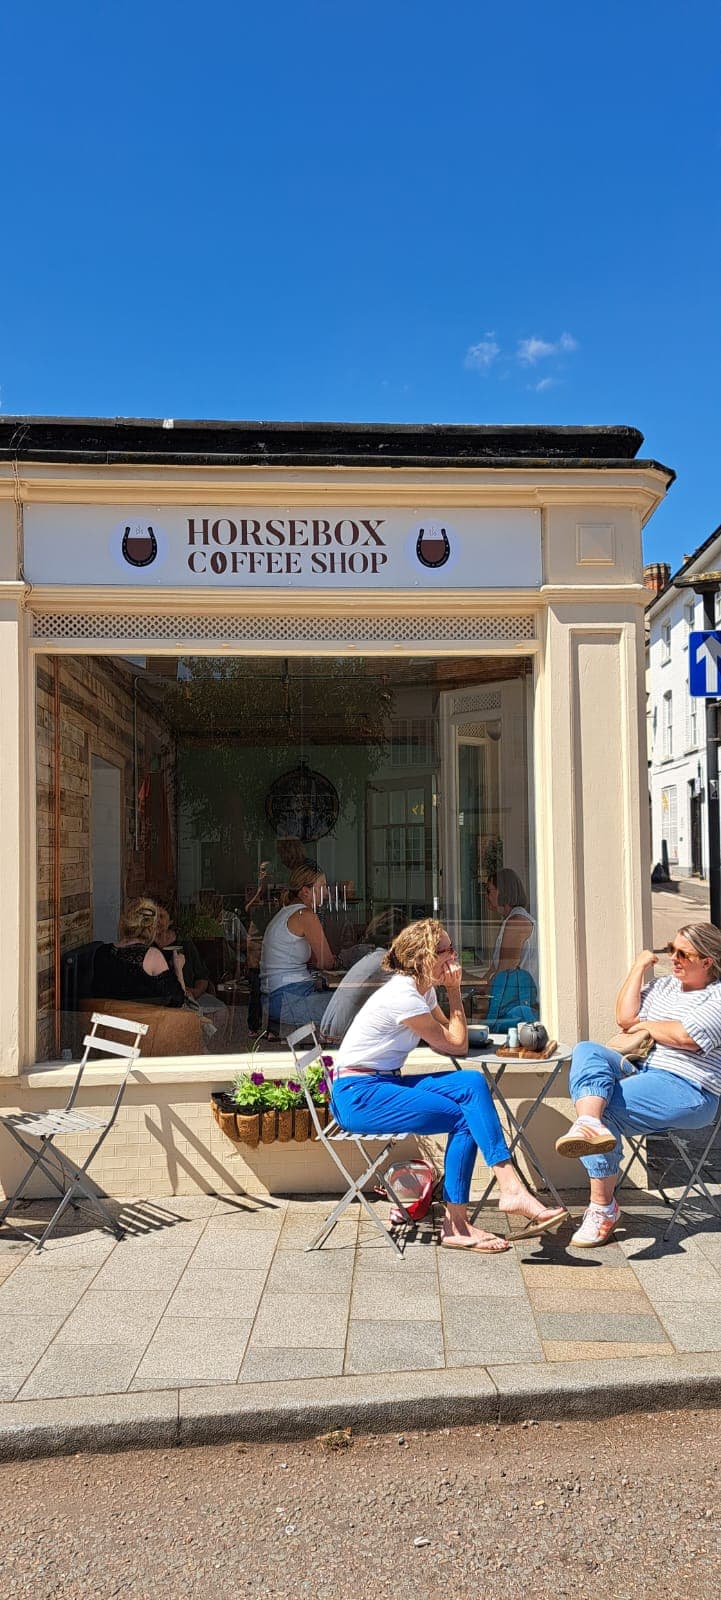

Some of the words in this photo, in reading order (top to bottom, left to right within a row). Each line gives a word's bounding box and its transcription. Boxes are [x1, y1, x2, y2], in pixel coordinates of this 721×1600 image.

[187, 518, 387, 546] HORSEBOX
[187, 551, 302, 575] COFFEE
[310, 552, 388, 574] SHOP
